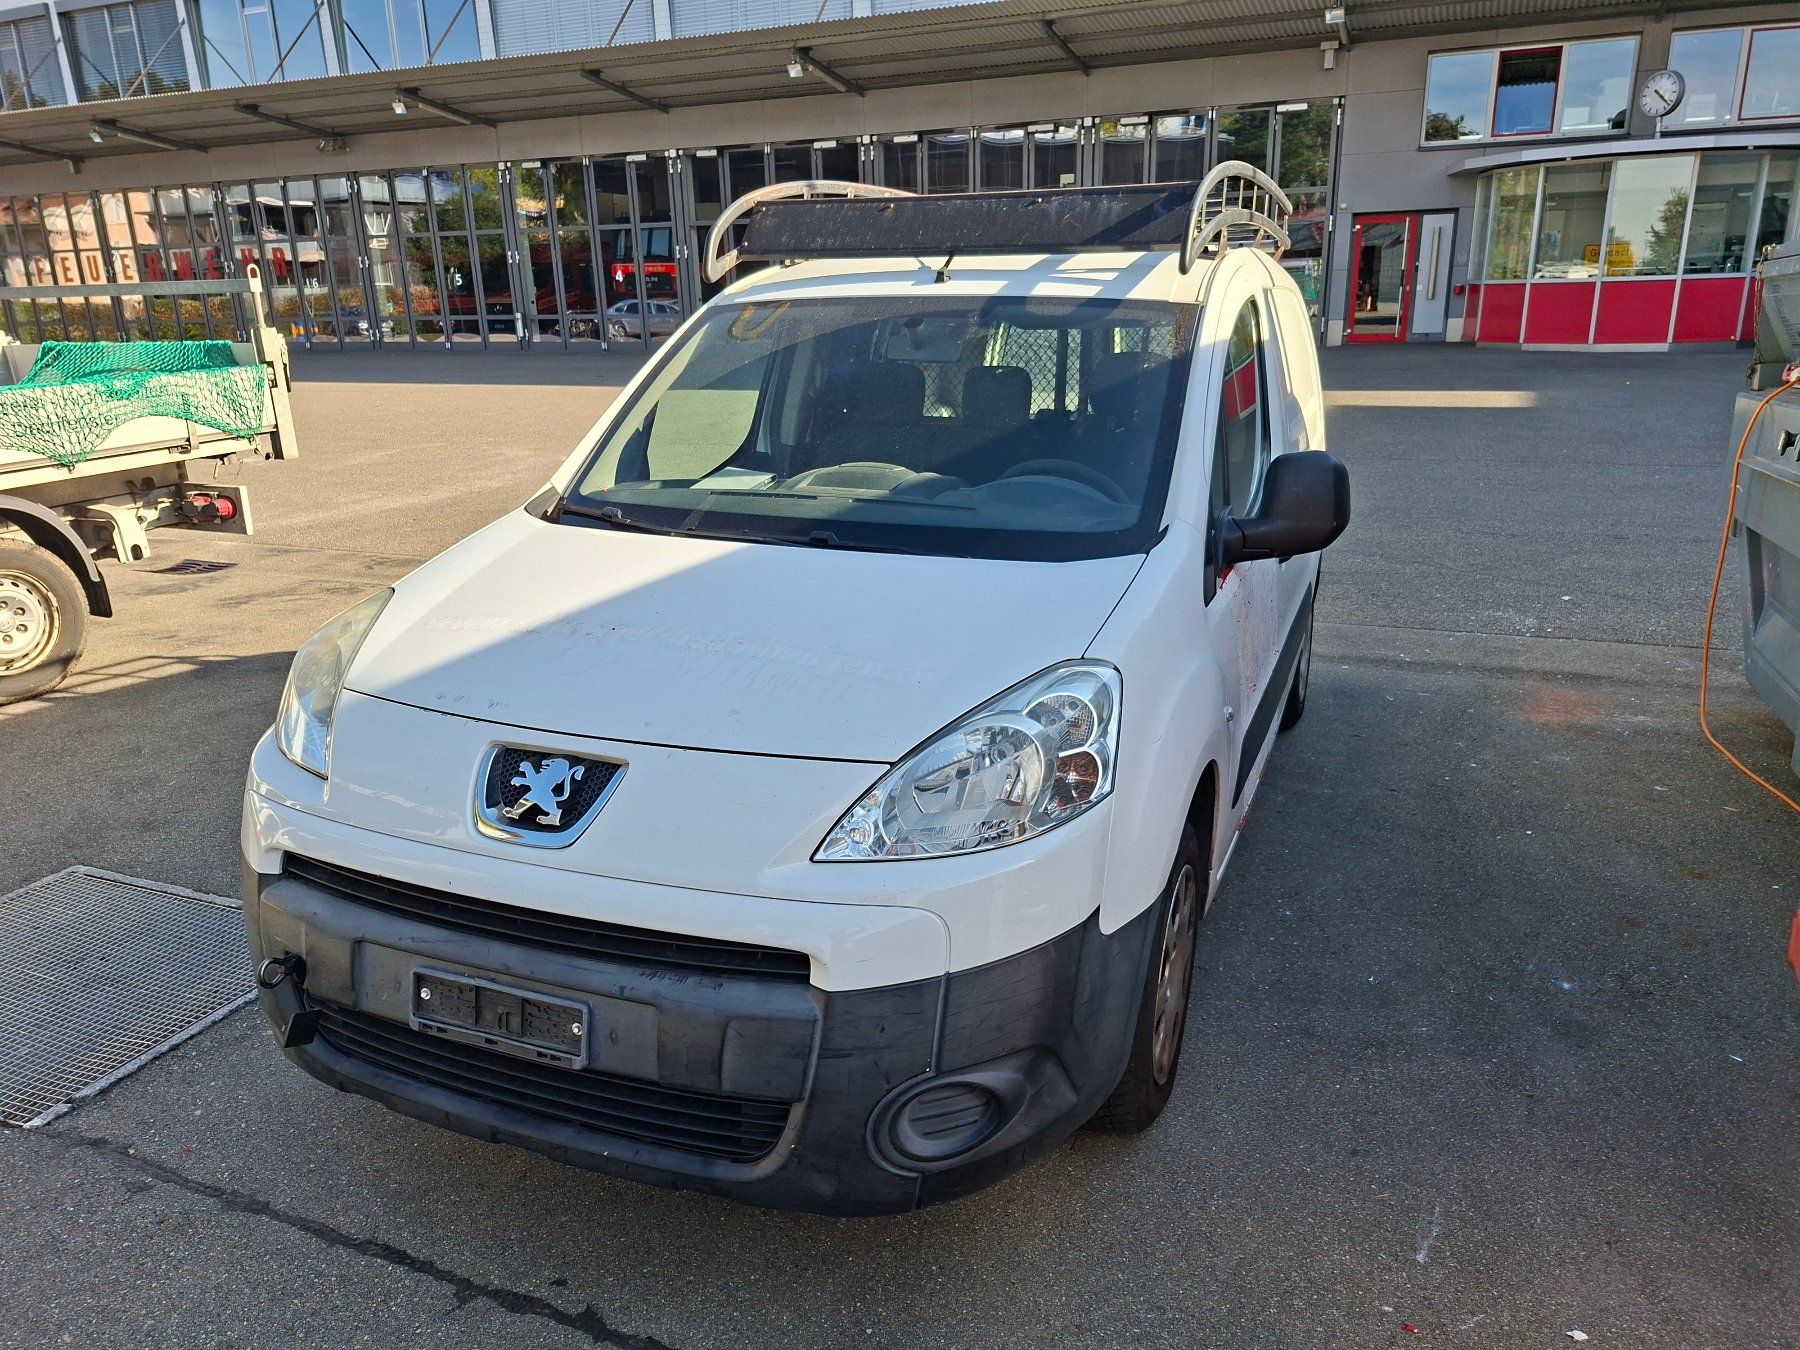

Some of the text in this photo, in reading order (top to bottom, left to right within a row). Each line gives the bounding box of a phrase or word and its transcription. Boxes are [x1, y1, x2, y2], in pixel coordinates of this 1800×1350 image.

[33, 246, 289, 284] FEUERWEHR
[455, 273, 463, 286] 5
[615, 270, 624, 282] 4
